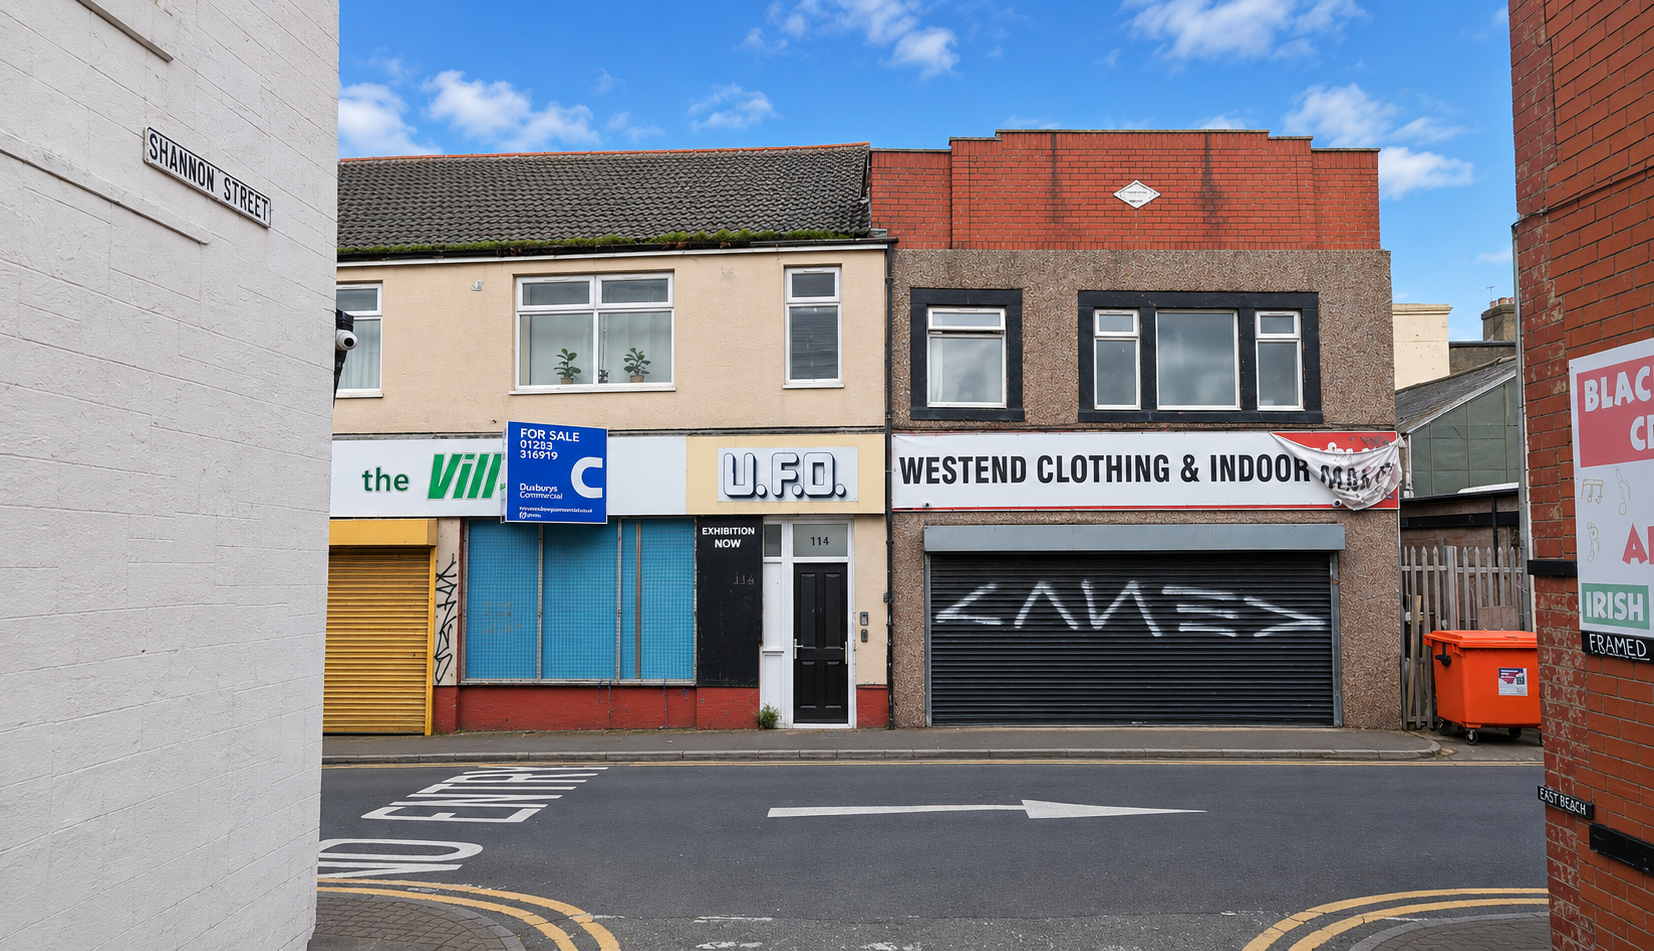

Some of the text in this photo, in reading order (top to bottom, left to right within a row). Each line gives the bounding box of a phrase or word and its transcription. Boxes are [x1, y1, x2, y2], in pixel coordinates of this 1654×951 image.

[149, 133, 268, 221] SHANNON STREET
[1584, 365, 1654, 413] BLAC
[520, 428, 580, 442] FOR SALE
[520, 450, 558, 460] 316919
[899, 456, 1026, 484] WESTEND
[1037, 454, 1170, 484] CLOTHING
[1180, 454, 1200, 483] &
[1210, 454, 1310, 482] INDOOR
[361, 452, 505, 500] the Vill
[723, 452, 846, 499] U.F.O.
[702, 527, 755, 535] EXHIBITION
[714, 539, 741, 548] NOW
[810, 536, 830, 546] 114
[1622, 523, 1654, 565] A
[1586, 591, 1644, 622] IRISH
[1589, 633, 1647, 658] FRAMED
[361, 766, 609, 822] ENTRY
[1540, 788, 1587, 815] EAST BEACH
